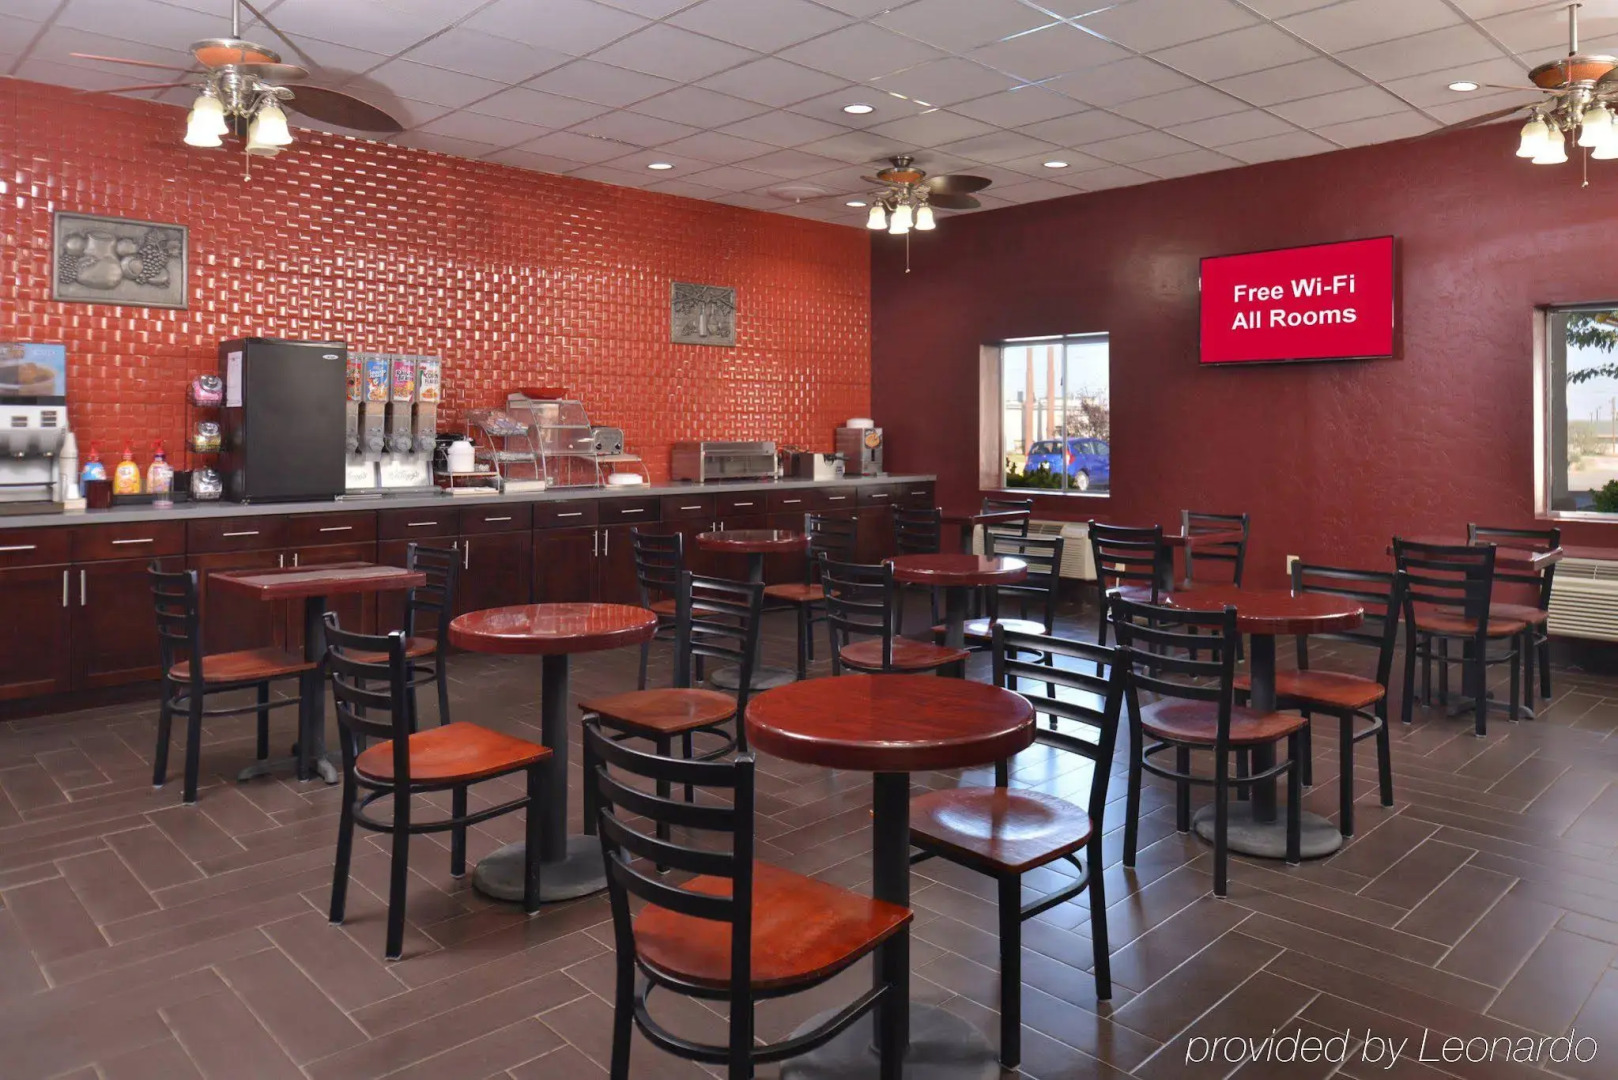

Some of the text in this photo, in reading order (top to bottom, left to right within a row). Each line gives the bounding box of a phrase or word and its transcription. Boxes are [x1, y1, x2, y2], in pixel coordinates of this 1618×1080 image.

[1234, 274, 1355, 303] Free Wi-Fi
[1231, 307, 1357, 330] All Rooms
